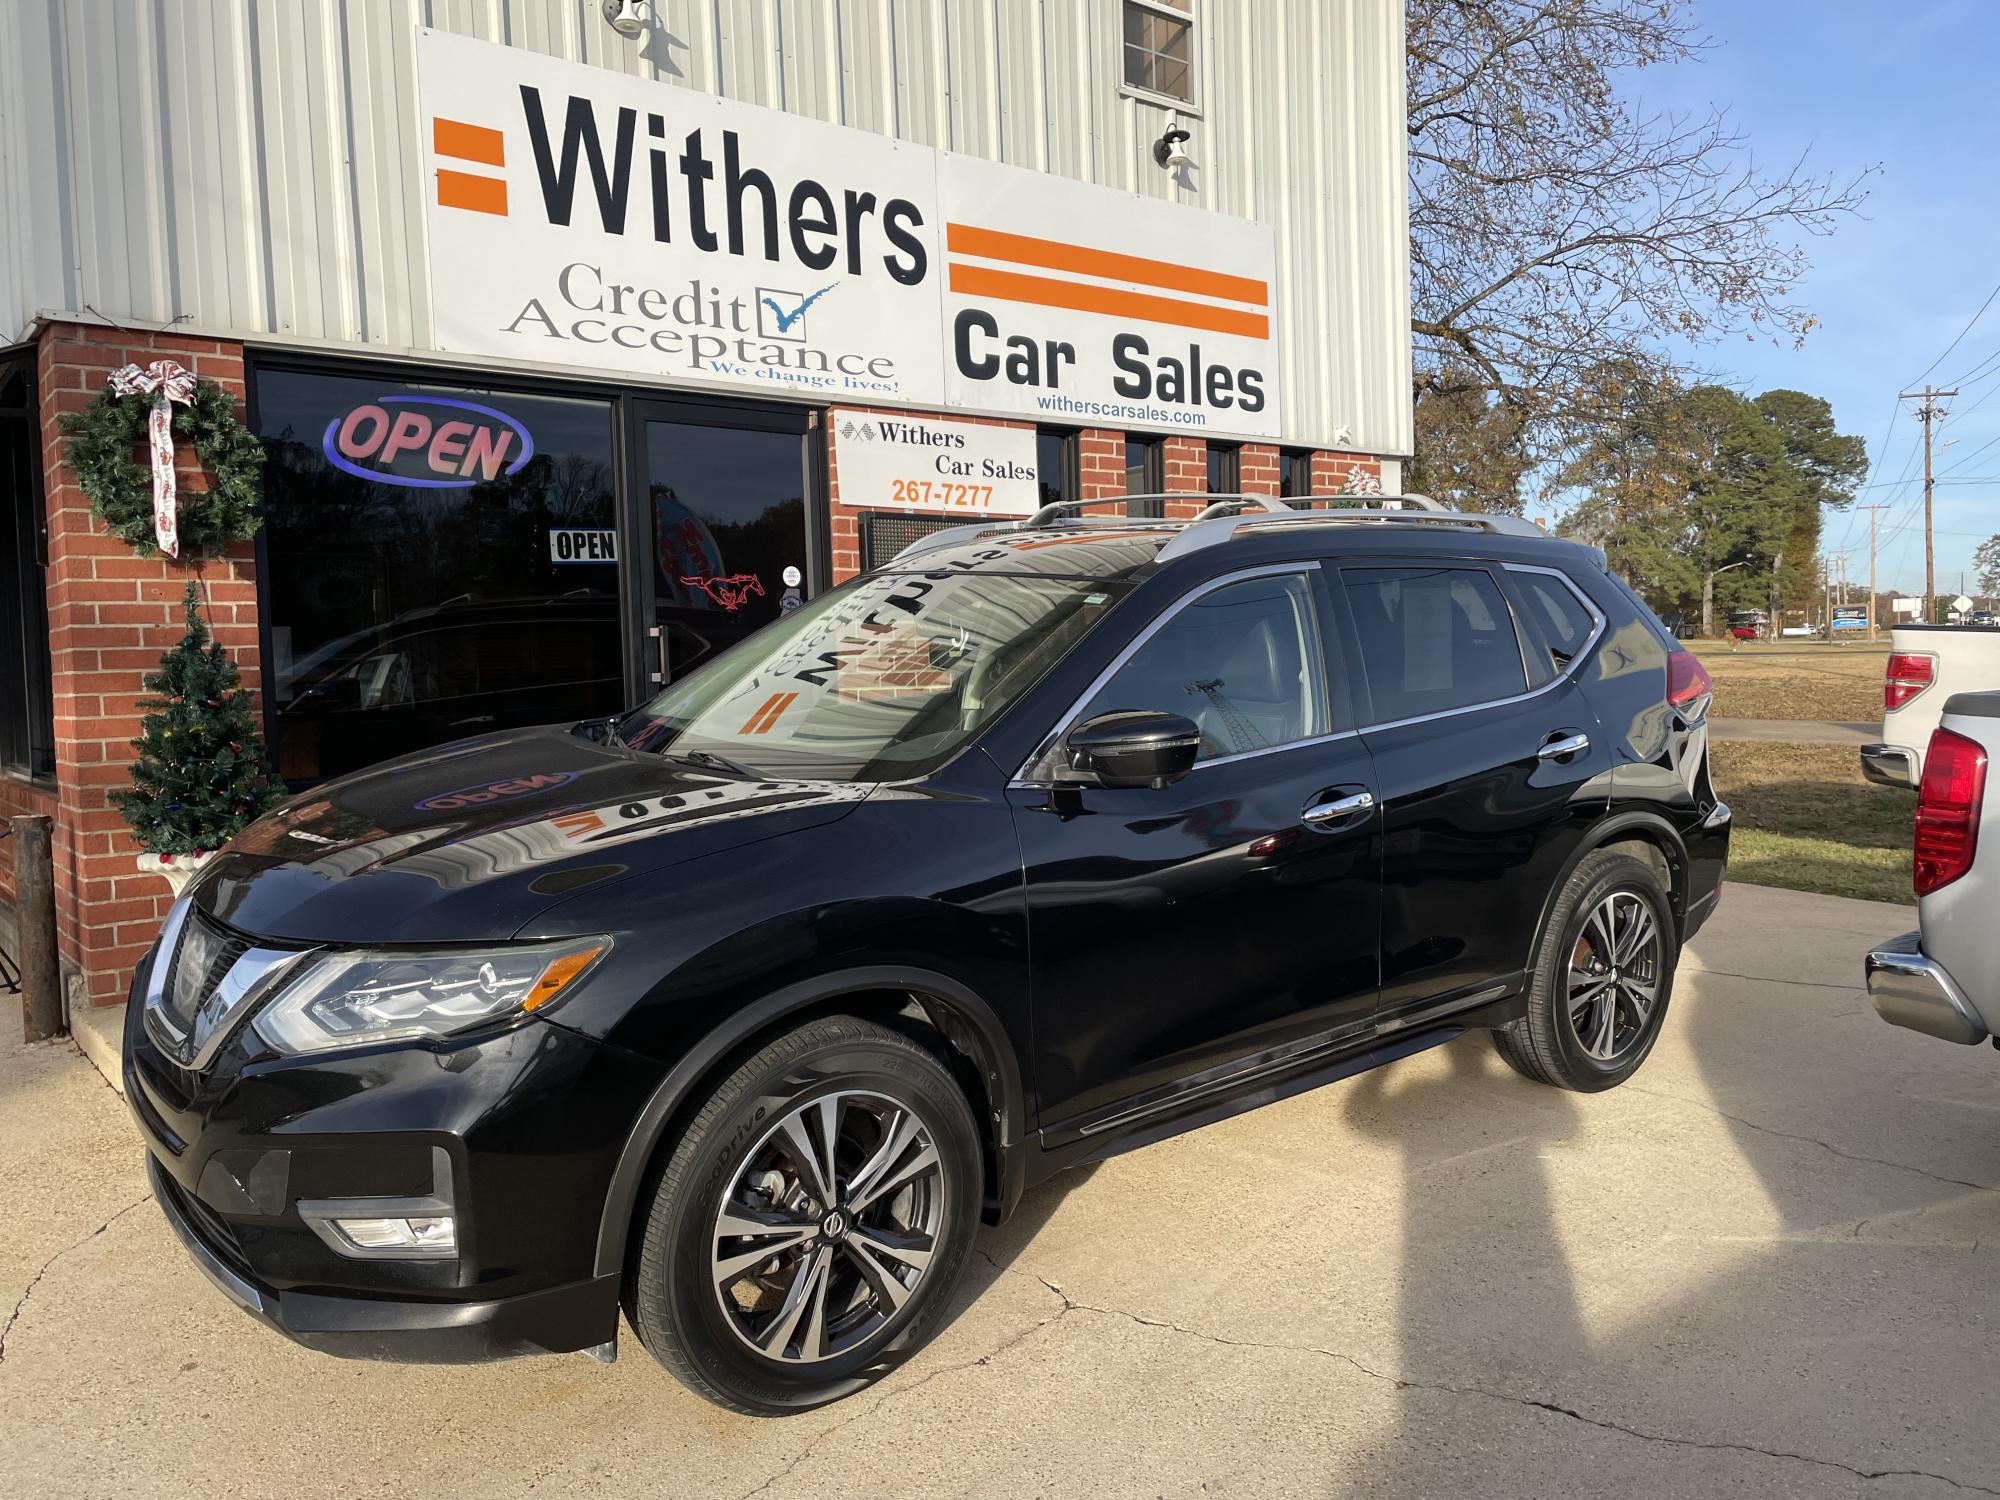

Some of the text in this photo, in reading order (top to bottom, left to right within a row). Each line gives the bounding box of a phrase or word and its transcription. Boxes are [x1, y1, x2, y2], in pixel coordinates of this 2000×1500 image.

[519, 84, 928, 286] Withers
[558, 262, 750, 333] Credit
[498, 298, 894, 379] Acceptance
[710, 360, 899, 393] We change lives!
[954, 308, 1265, 413] Car Sales
[1037, 394, 1206, 426] witherscarsales.com
[338, 404, 514, 481] OPEN
[878, 421, 965, 449] Withers
[935, 454, 1036, 481] Car Sales
[892, 479, 993, 508] 267-7277
[556, 531, 615, 560] OPEN
